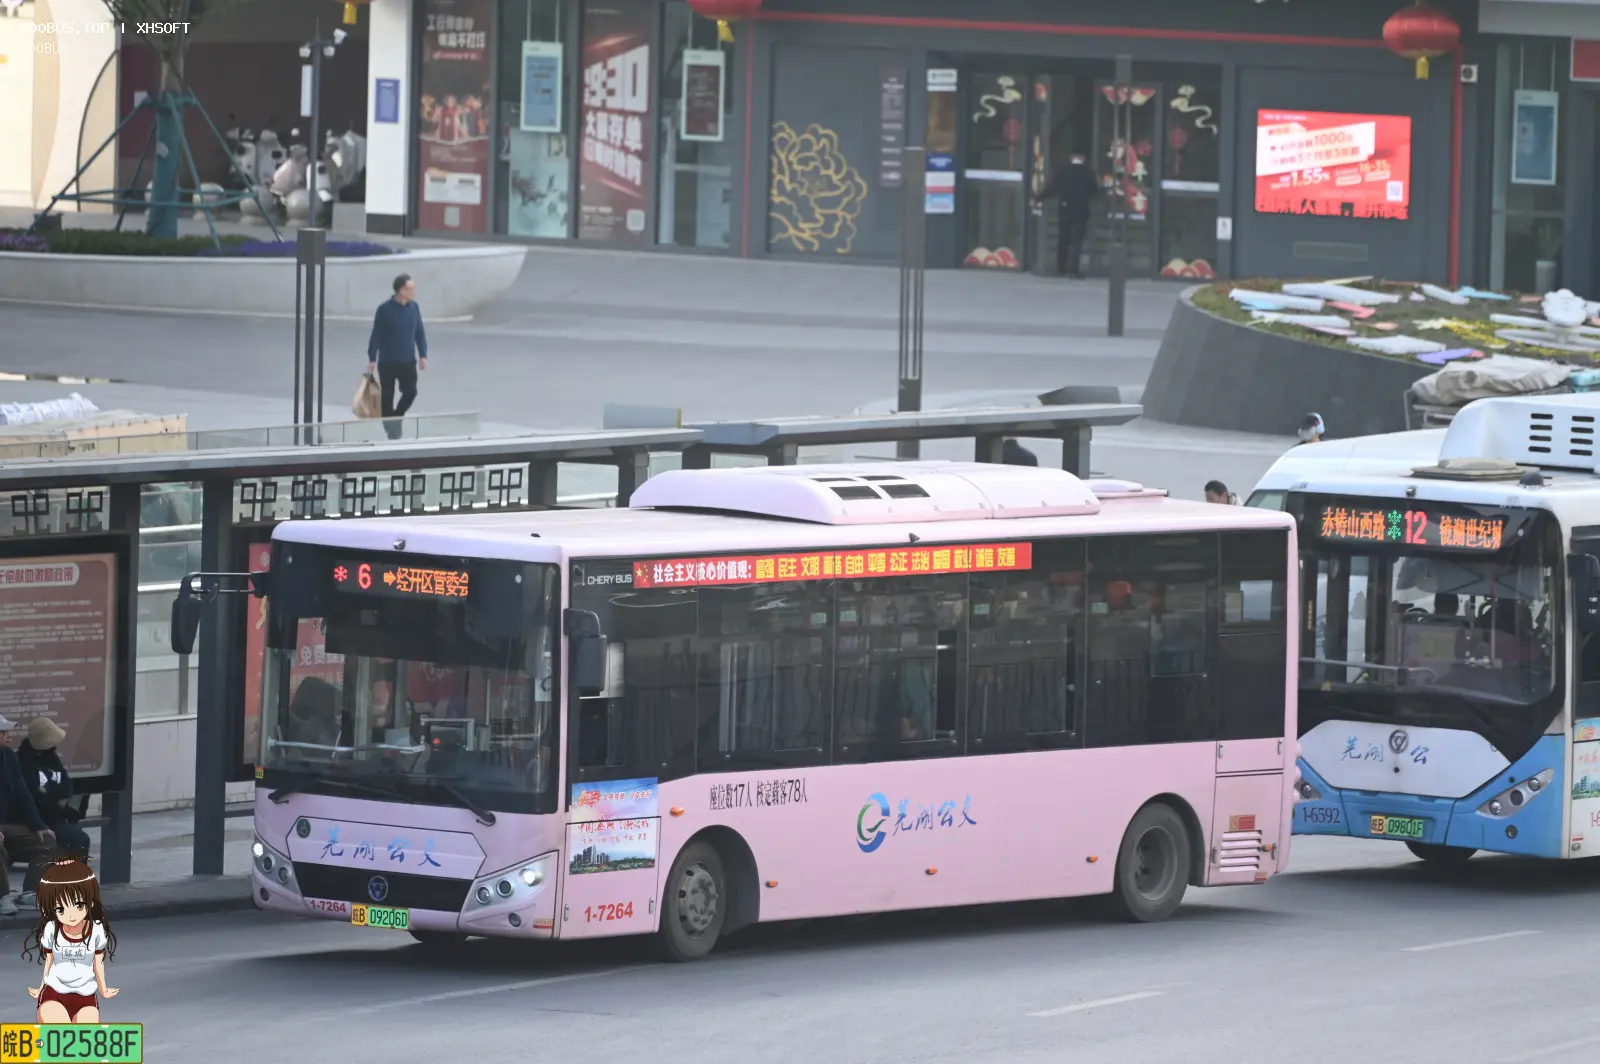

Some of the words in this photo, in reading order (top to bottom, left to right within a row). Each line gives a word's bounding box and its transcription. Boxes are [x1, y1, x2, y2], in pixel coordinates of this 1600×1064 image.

[1320, 506, 1386, 541] 赤铸山西路
[1404, 510, 1428, 545] 12
[357, 563, 372, 590] 6
[396, 567, 469, 597] 经开区管委会
[587, 575, 615, 585] CHERY
[616, 574, 633, 584] BUS
[709, 783, 753, 811] 座位数17人
[756, 778, 808, 807] 核定载客78人
[1302, 807, 1341, 825] 1-6592
[310, 899, 347, 913] 1-7264
[584, 902, 633, 923] 1-7264
